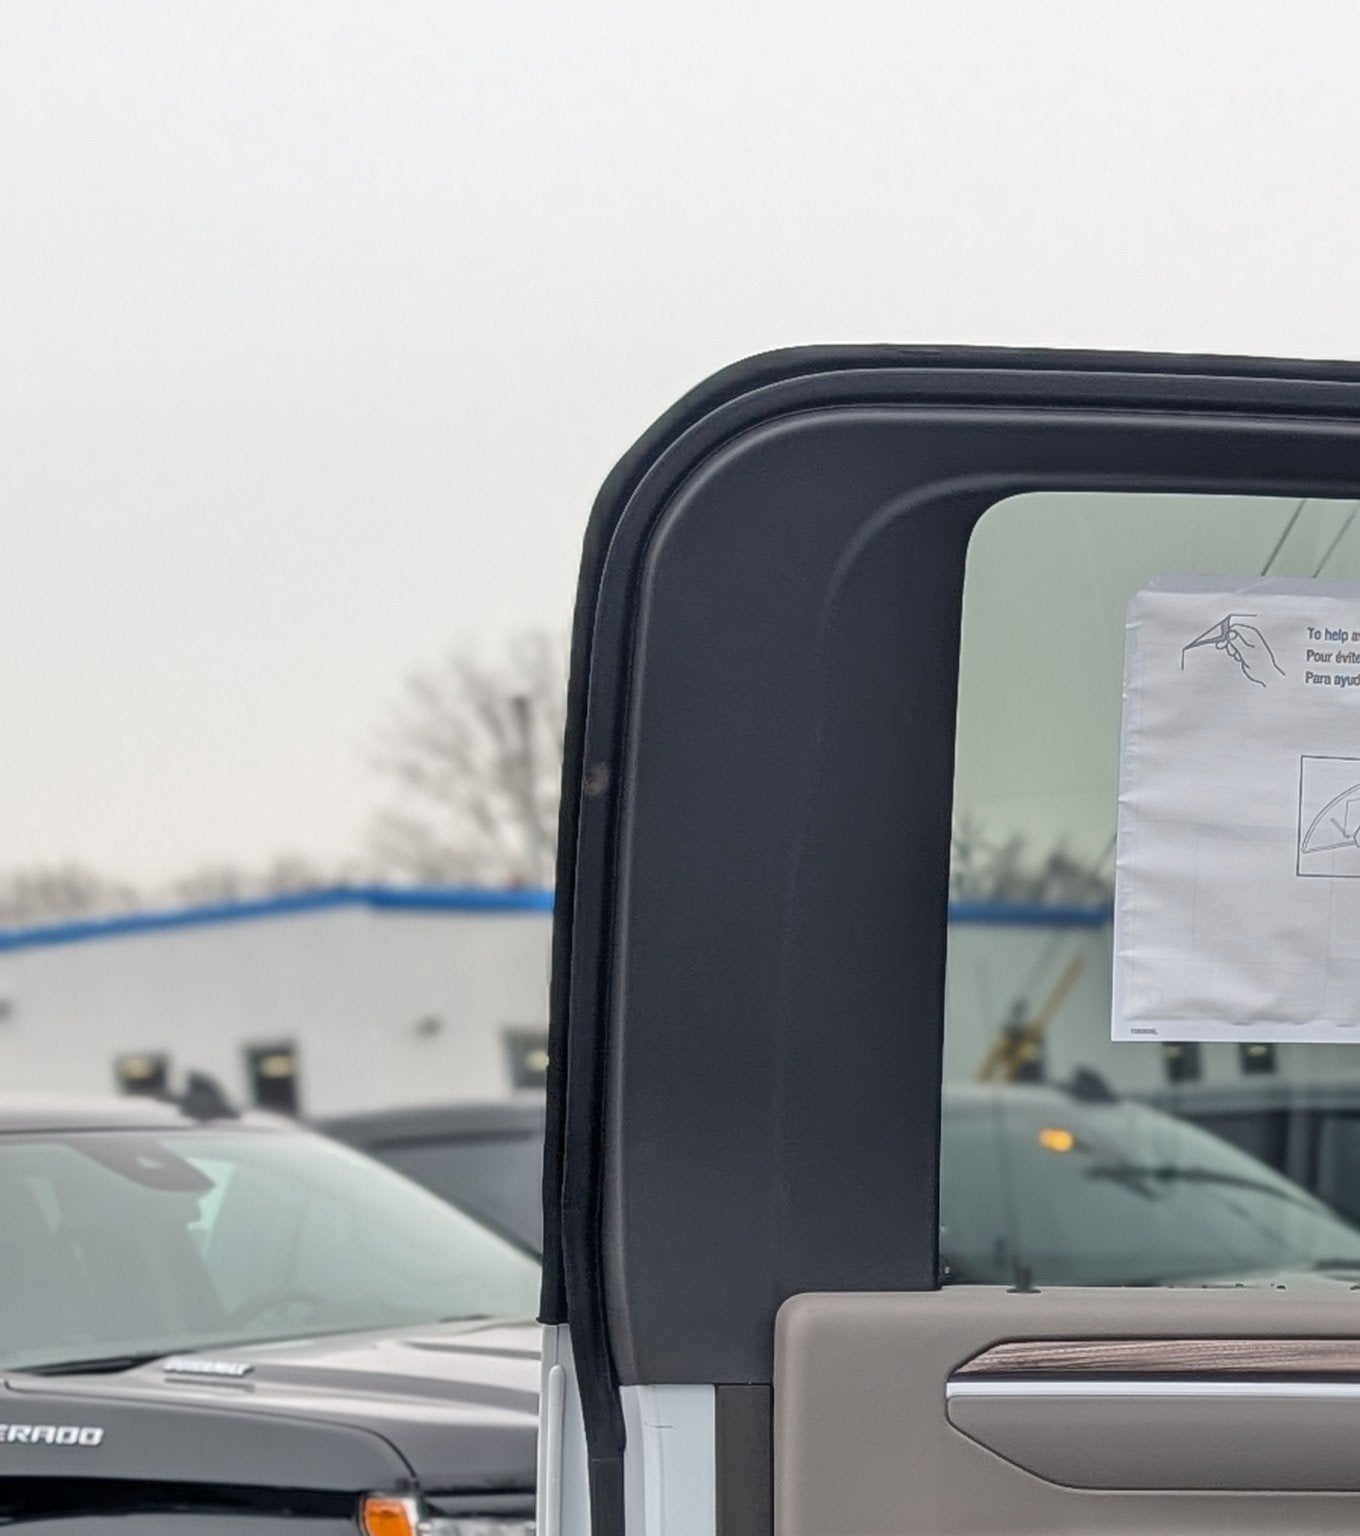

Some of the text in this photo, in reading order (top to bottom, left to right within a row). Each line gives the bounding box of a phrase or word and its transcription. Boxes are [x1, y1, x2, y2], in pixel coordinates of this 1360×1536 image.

[1307, 627, 1321, 640] To
[1325, 628, 1349, 644] help
[1306, 649, 1333, 663] Pour
[1305, 671, 1331, 685] Para
